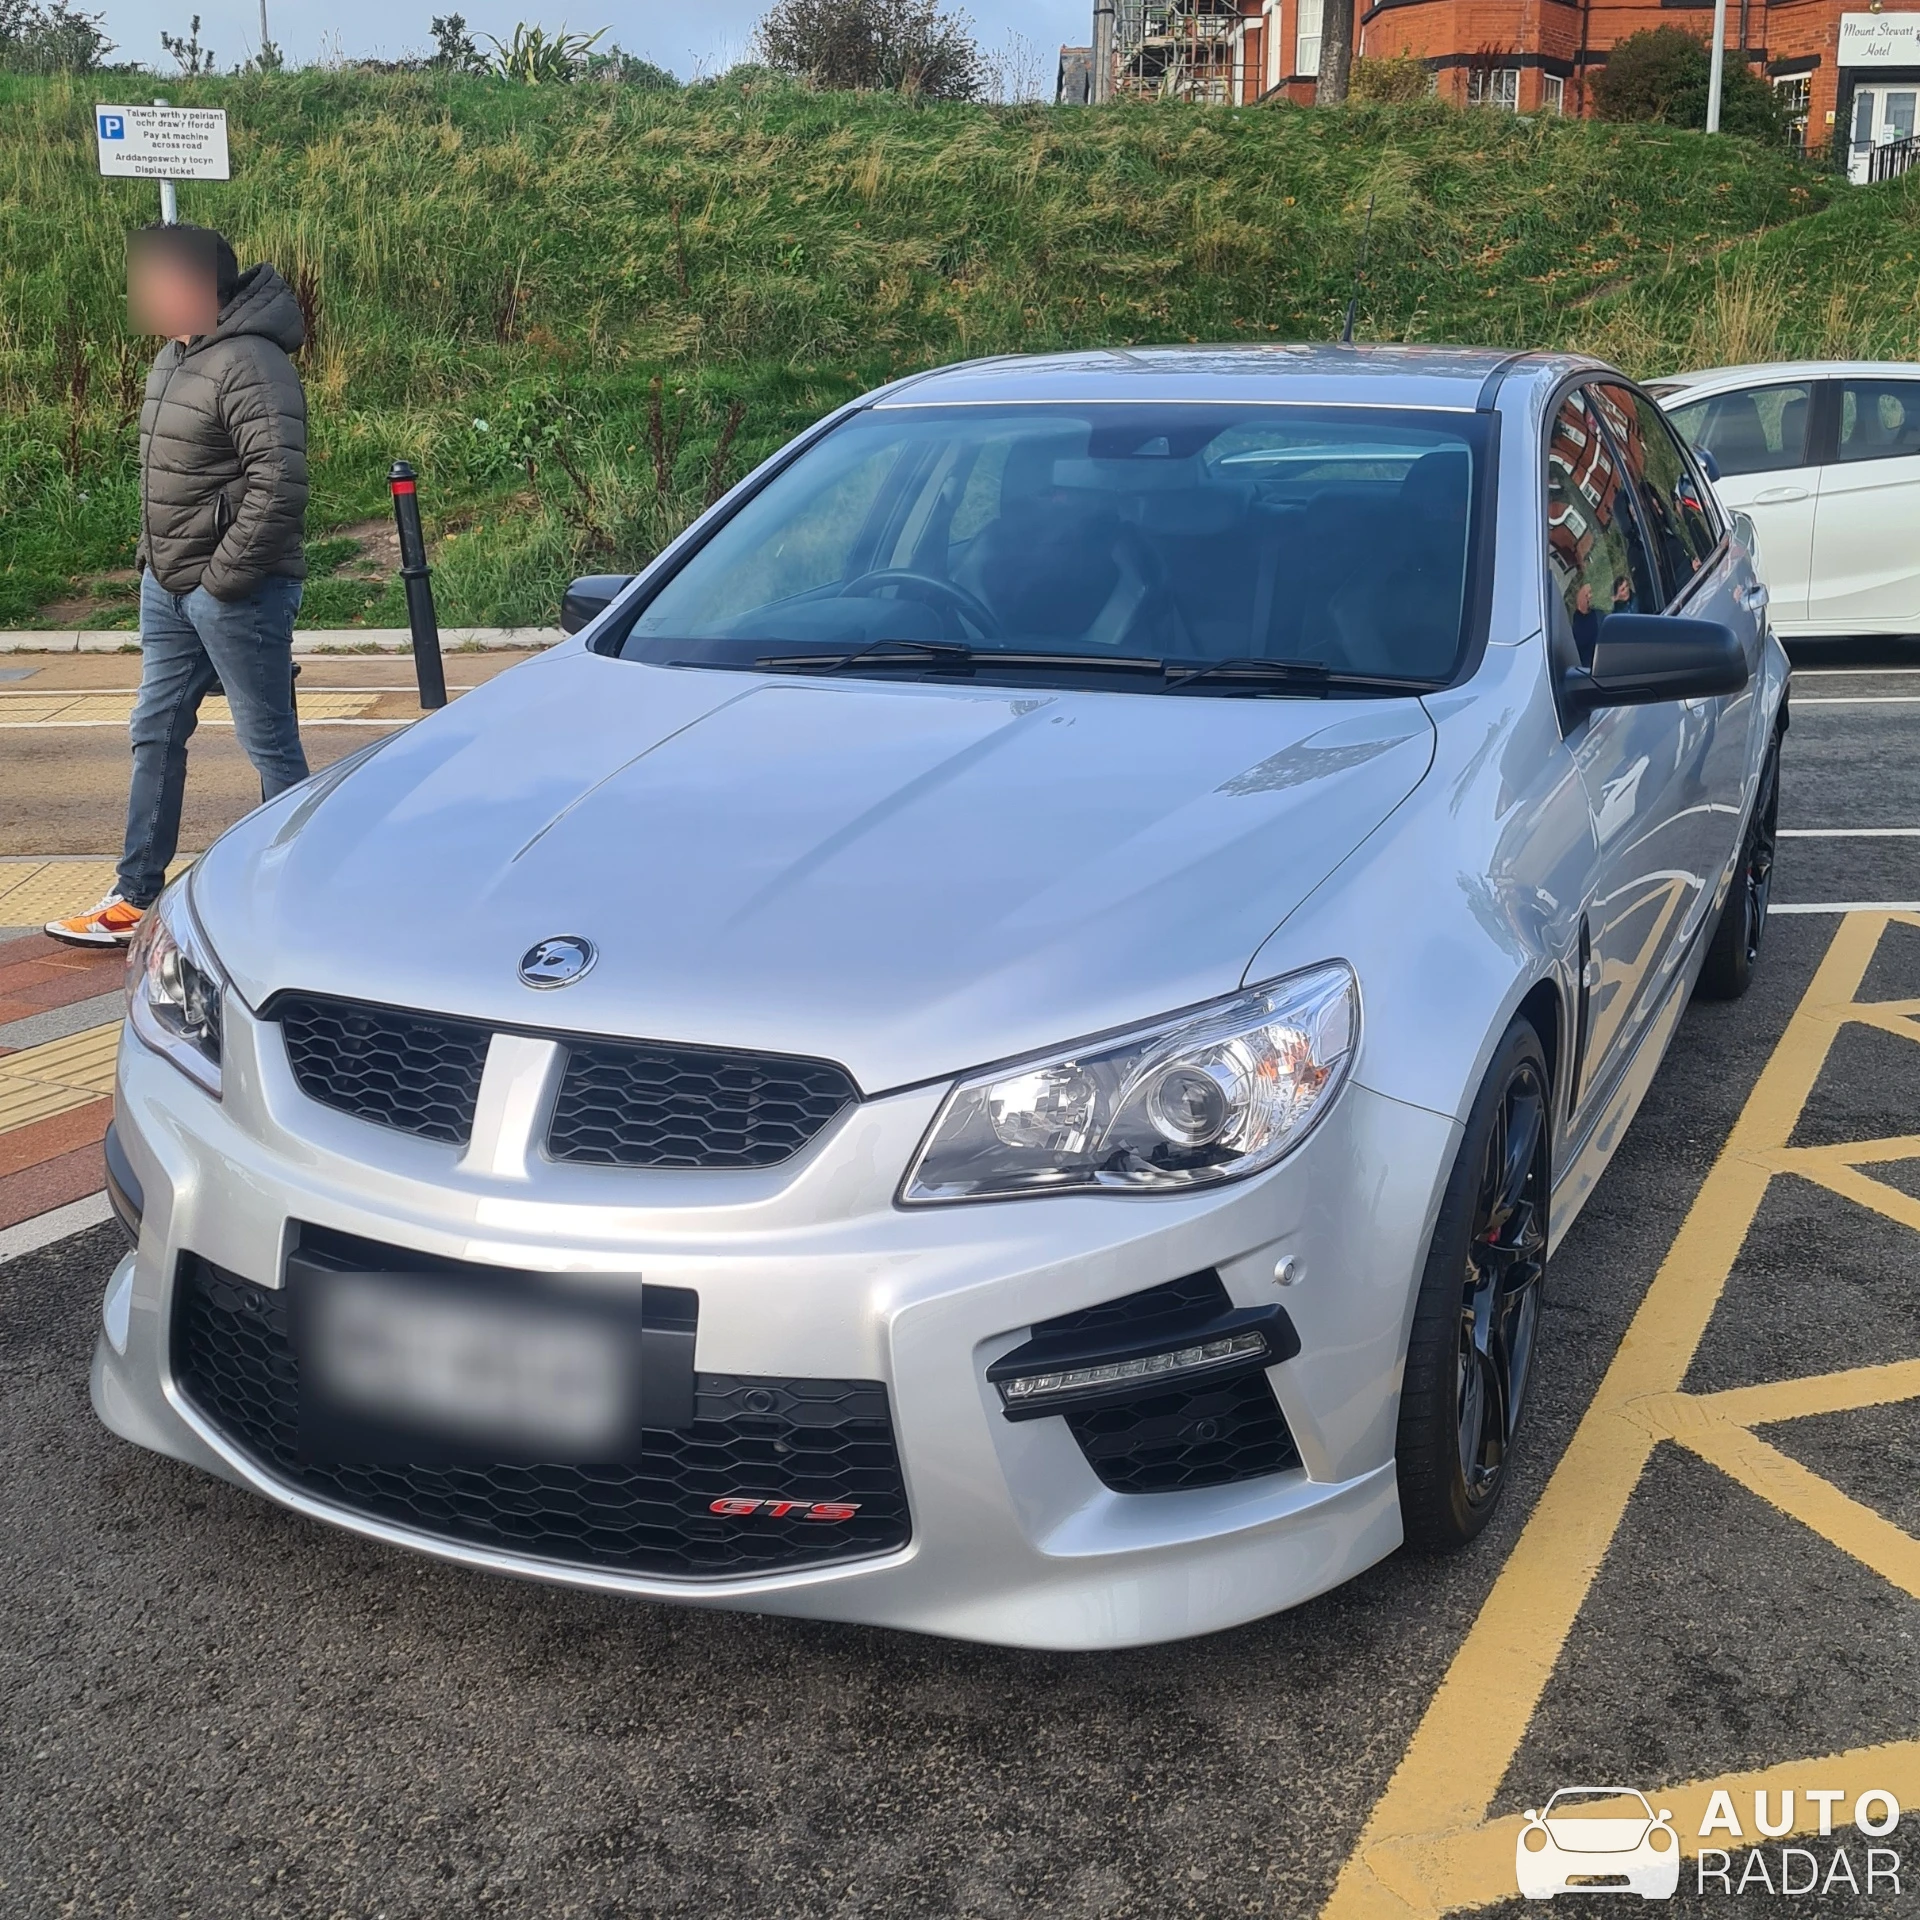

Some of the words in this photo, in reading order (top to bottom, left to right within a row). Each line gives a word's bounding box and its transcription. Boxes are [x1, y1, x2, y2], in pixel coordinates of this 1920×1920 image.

[1844, 23, 1875, 36] Mount
[1877, 22, 1913, 36] Stewart
[1861, 42, 1892, 56] Hotel
[126, 109, 157, 118] Talwch
[160, 111, 180, 119] wrth
[190, 112, 223, 120] peiriant
[105, 118, 120, 137] P
[136, 119, 155, 127] ochr
[158, 119, 185, 128] draw'r
[187, 121, 215, 129] ffordd
[143, 131, 159, 140] Pay
[173, 132, 209, 141] machine
[115, 153, 180, 163] Arddangoswch
[189, 156, 213, 165] tocyn
[135, 166, 167, 175] Display
[170, 167, 195, 175] ticket
[709, 1498, 862, 1520] GTS
